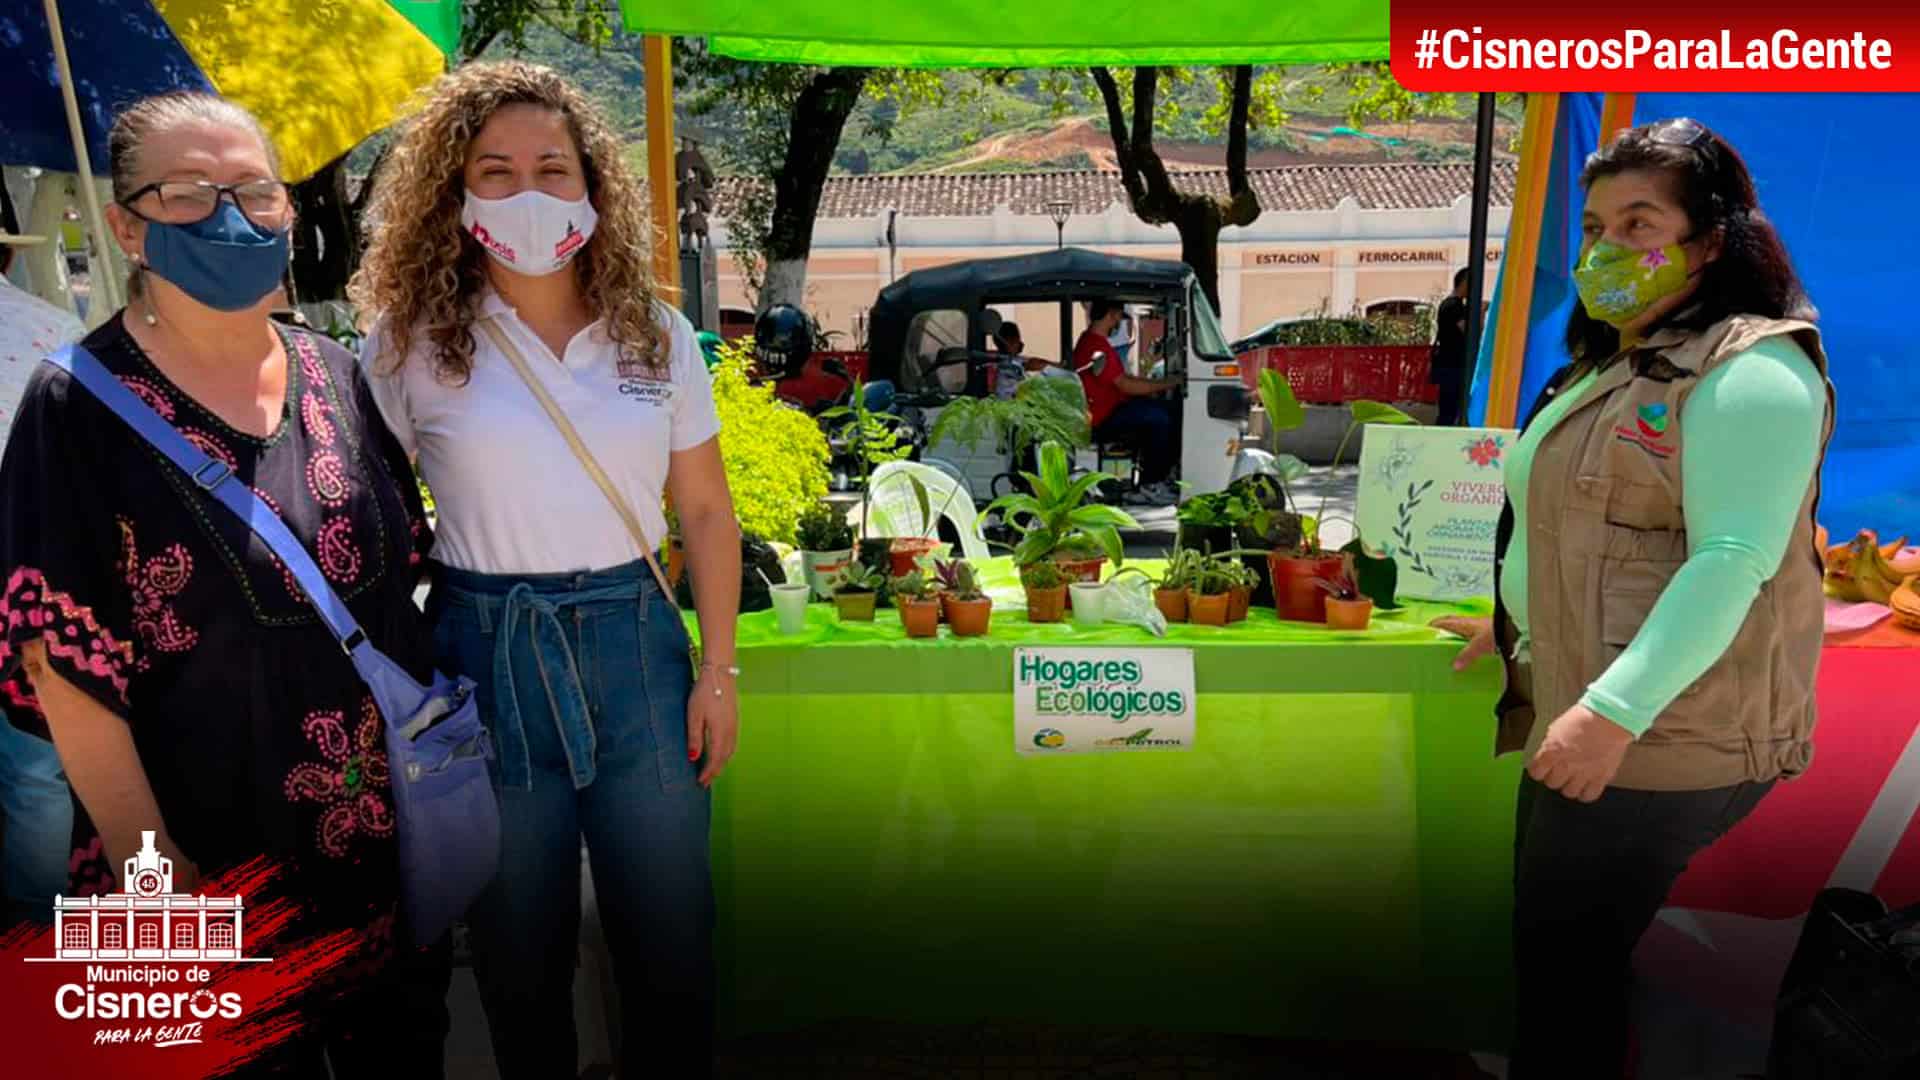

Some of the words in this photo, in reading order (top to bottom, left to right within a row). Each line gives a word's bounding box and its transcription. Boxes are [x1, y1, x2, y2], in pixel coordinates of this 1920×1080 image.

[1359, 251, 1446, 262] FERROCARRIL
[1020, 655, 1141, 689] Hogares
[1036, 686, 1184, 720] Ecológicos
